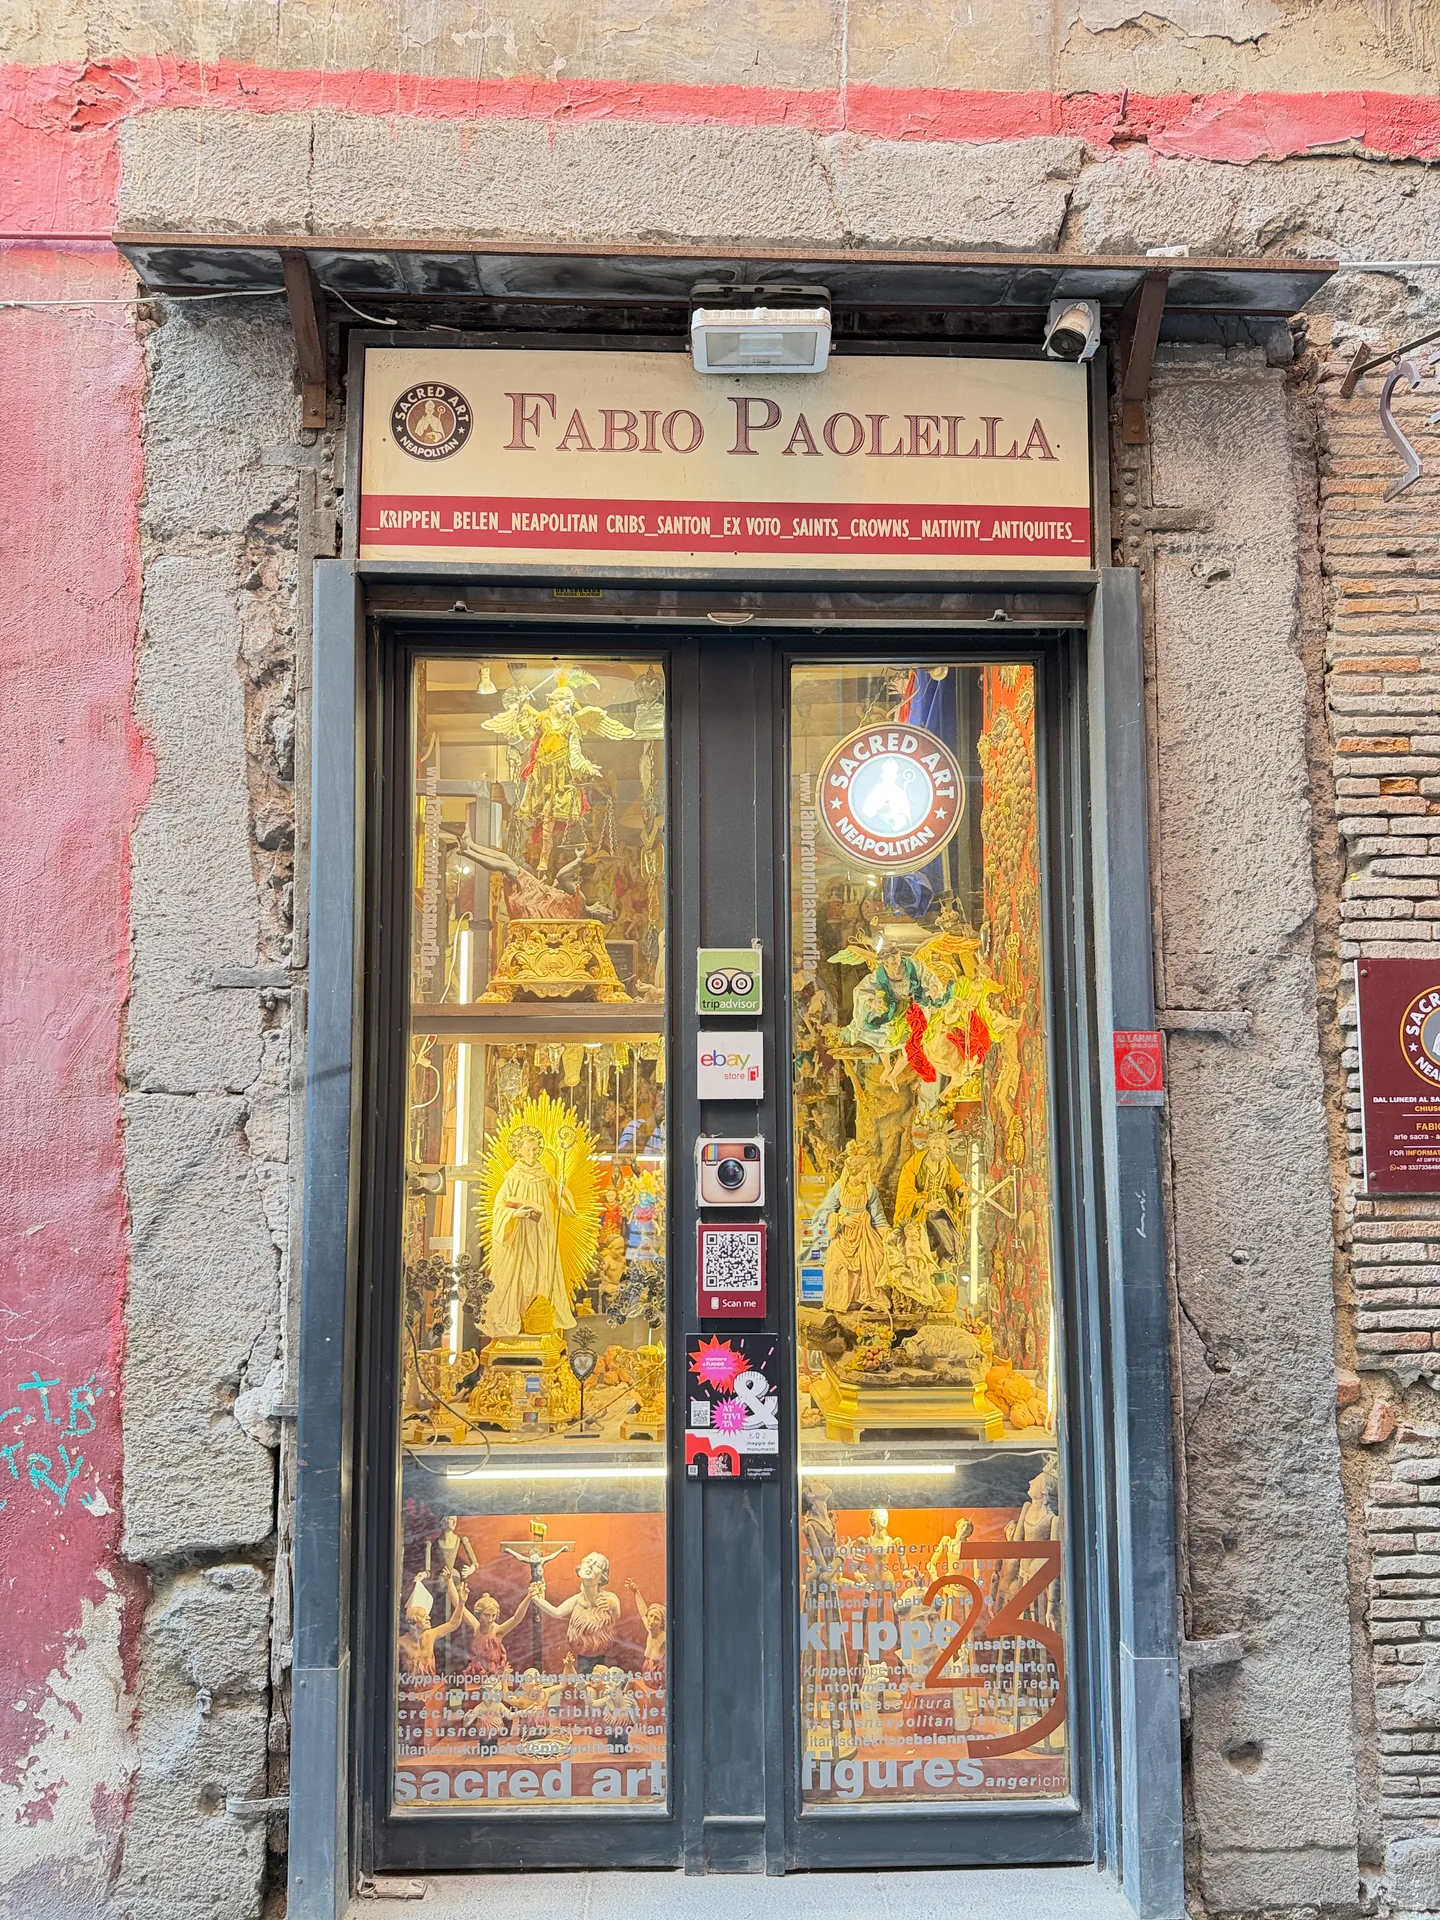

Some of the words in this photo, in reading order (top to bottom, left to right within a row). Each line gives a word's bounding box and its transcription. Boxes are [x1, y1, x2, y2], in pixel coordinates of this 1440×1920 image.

[395, 386, 446, 421] SACRED
[447, 395, 470, 422] ART
[503, 392, 705, 454] FABIO
[726, 396, 1060, 462] PAOLELLA
[399, 435, 460, 458] NEAPOLITAN
[830, 732, 919, 790] SACRED
[920, 752, 955, 799] ART
[835, 816, 936, 857] NEAPOLITAN
[702, 999, 758, 1010] tripadvisor
[700, 1050, 750, 1070] ebay
[724, 1072, 745, 1080] store
[1414, 1056, 1440, 1082] NEA
[722, 1299, 745, 1308] Scan
[800, 1612, 961, 1660] krippe
[395, 1761, 572, 1800] sacred
[592, 1760, 667, 1799] art
[801, 1752, 985, 1799] figures
